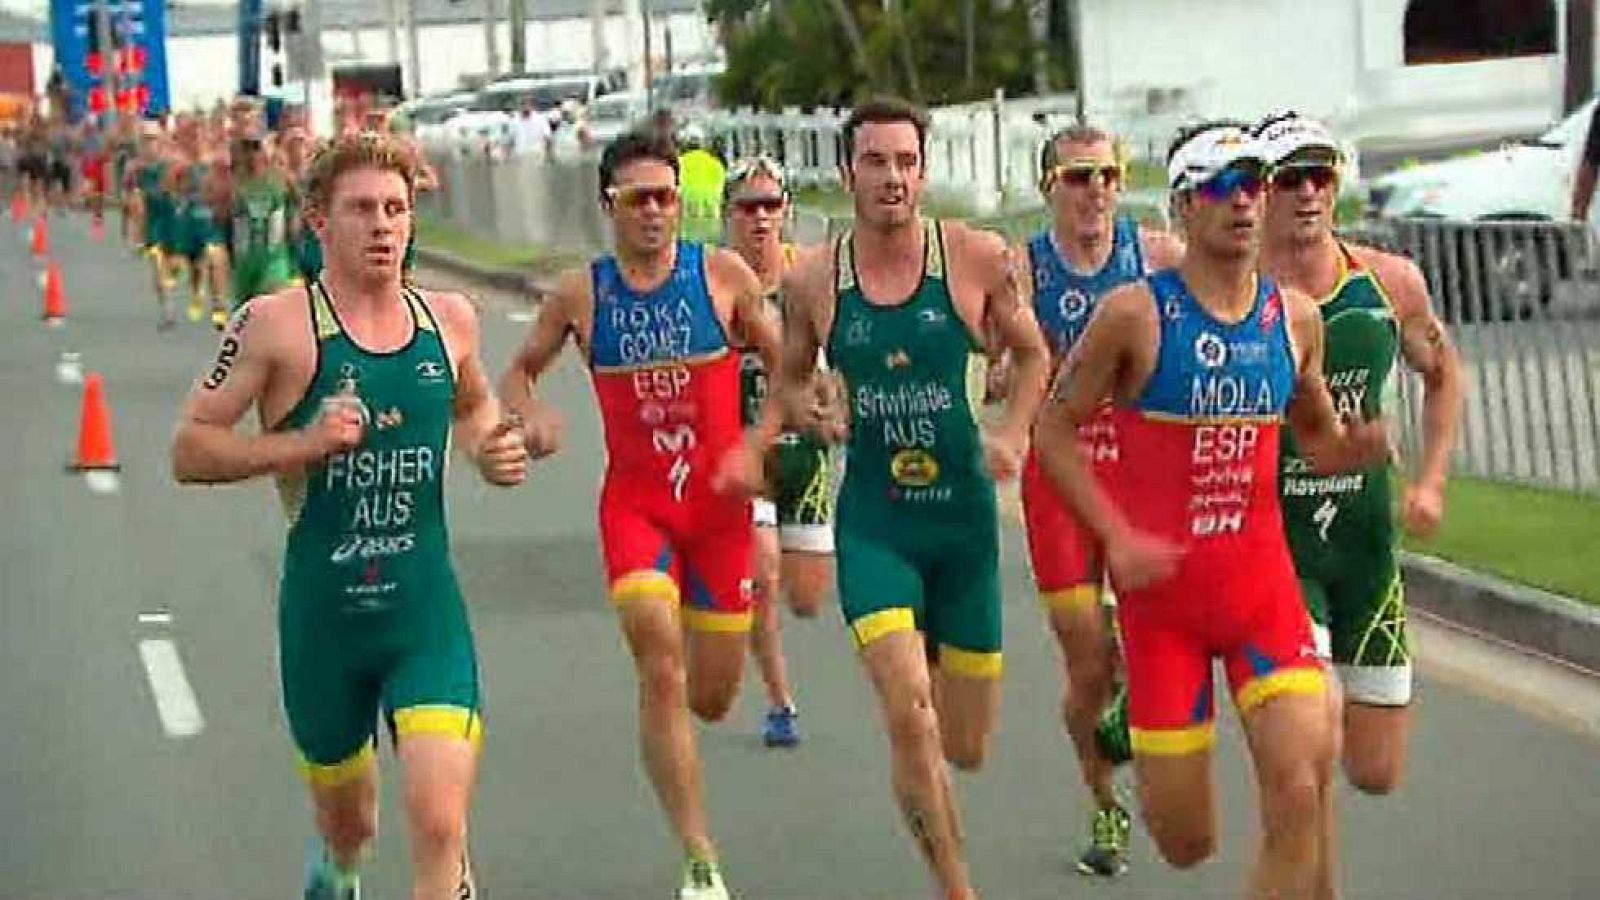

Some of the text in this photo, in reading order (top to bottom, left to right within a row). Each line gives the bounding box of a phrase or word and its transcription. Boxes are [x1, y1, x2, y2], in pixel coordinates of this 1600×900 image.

[633, 365, 690, 399] ESP
[1190, 374, 1273, 416] MOLA
[884, 417, 936, 446] AUS
[1192, 424, 1258, 463] ESP
[325, 446, 434, 490] FISHER
[351, 490, 415, 528] AUS
